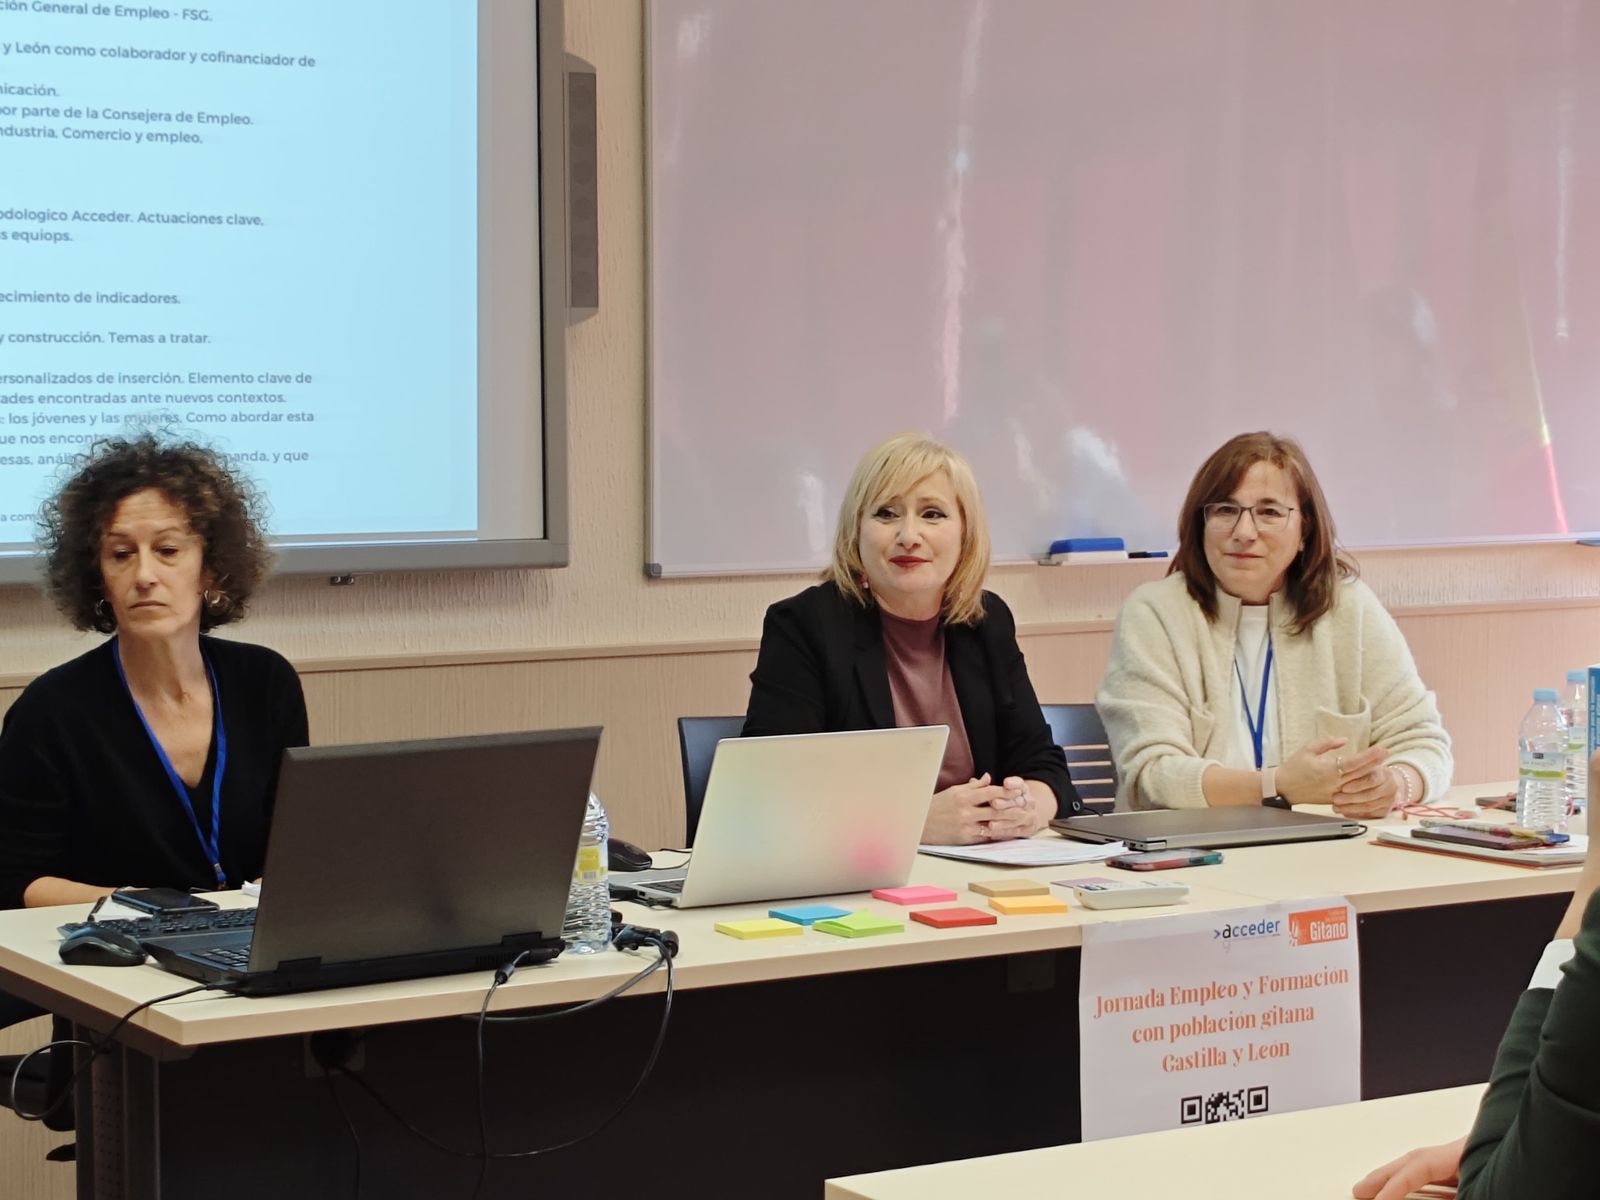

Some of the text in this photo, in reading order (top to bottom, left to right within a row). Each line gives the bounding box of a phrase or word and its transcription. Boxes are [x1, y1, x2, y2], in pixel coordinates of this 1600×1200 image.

[32, 0, 88, 14] General
[92, 4, 110, 16] de
[115, 5, 170, 20] Empleo
[182, 8, 212, 21] FSG.
[3, 42, 315, 67] y León como colaborador y cofinanciador de
[0, 106, 254, 127] or parte de la Consejera de Empleo.
[62, 127, 131, 141] Comercio
[135, 132, 143, 144] y
[72, 210, 133, 222] Acceder.
[137, 212, 223, 224] Actuaciones
[11, 229, 72, 244] equiops.
[74, 292, 92, 303] de
[96, 292, 180, 304] indicadores.
[8, 331, 104, 343] construcción.
[108, 332, 154, 343] Temas
[158, 335, 166, 343] a
[170, 334, 211, 343] tratar.
[96, 372, 114, 384] de
[118, 372, 184, 384] inserción.
[188, 372, 254, 384] Elemento
[257, 372, 292, 383] clave
[295, 372, 312, 383] de
[38, 392, 127, 404] encontradas
[130, 393, 161, 403] ante
[165, 394, 214, 403] nuevos
[217, 393, 287, 403] contextos.
[9, 413, 29, 424] los
[31, 412, 86, 427] jóvenes
[89, 415, 98, 426] y
[101, 412, 120, 423] las
[186, 412, 227, 423] Como
[231, 411, 283, 422] abordar
[287, 412, 314, 422] esta
[20, 435, 45, 444] nos
[273, 453, 280, 464] y
[283, 452, 309, 463] que
[1309, 921, 1347, 941] Gitano
[1094, 966, 1349, 1019] Jornada Empleo y Formación
[1132, 1005, 1314, 1043] con población gitana
[1162, 1040, 1290, 1072] Castilla y León
